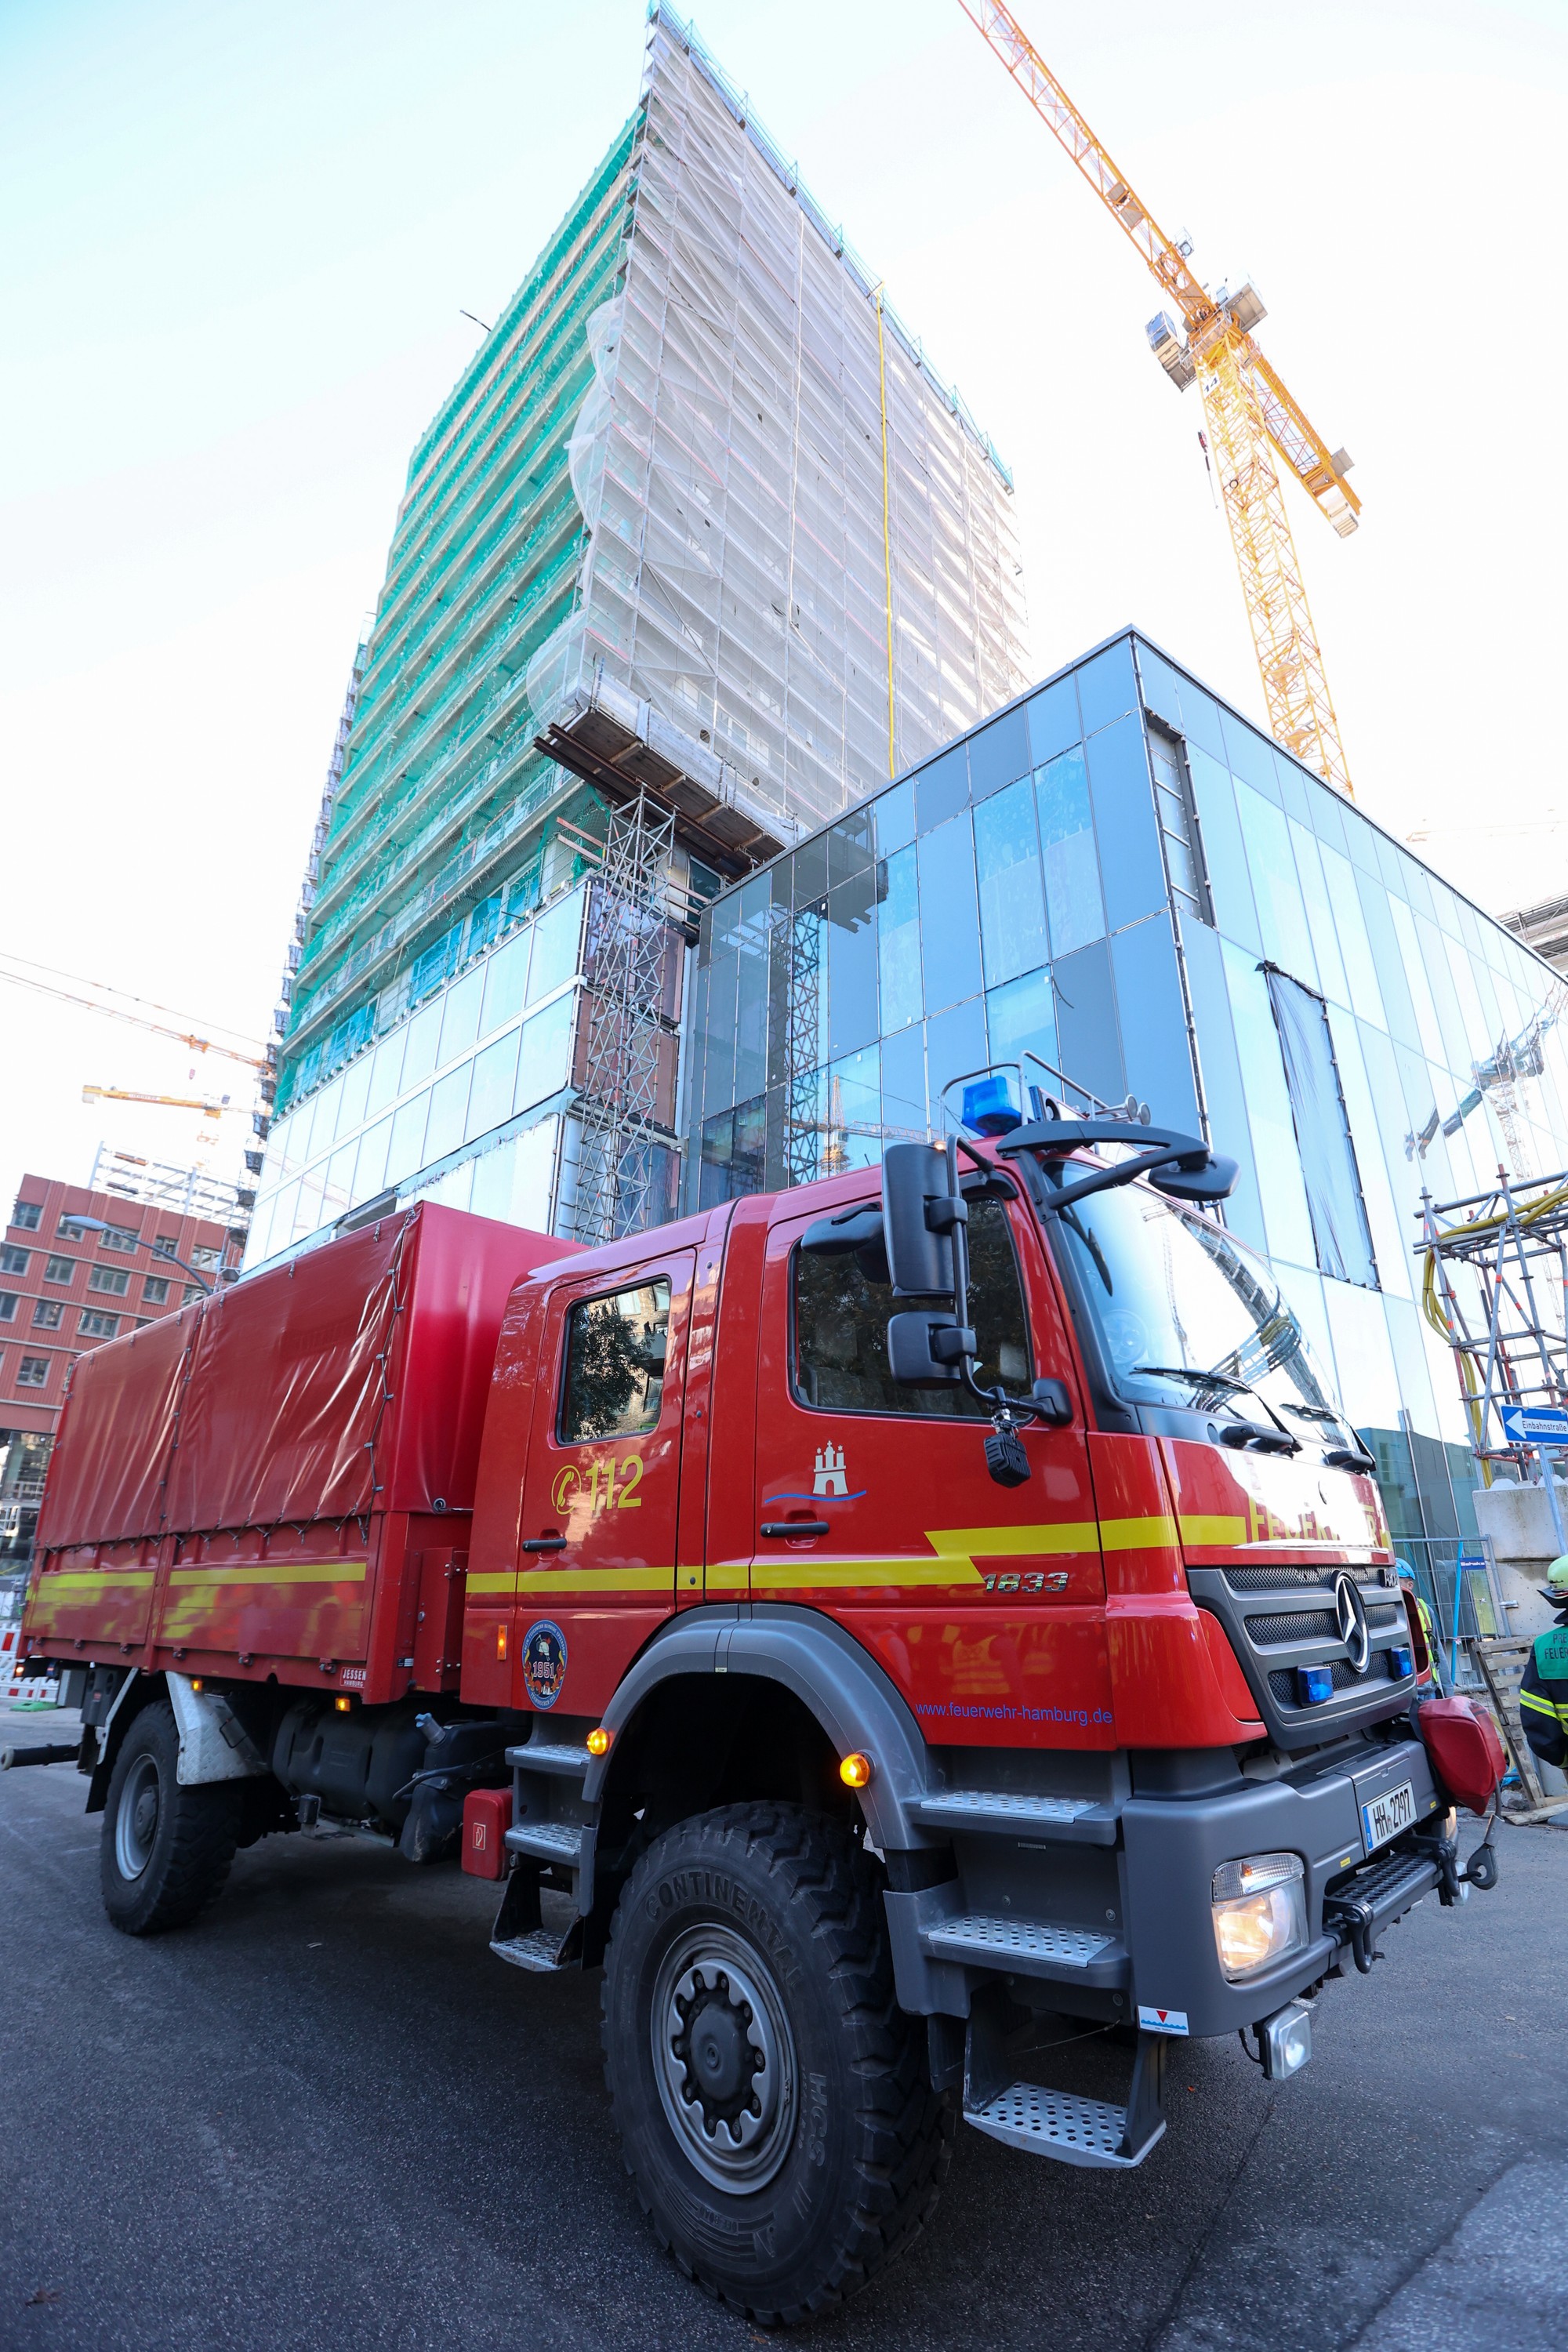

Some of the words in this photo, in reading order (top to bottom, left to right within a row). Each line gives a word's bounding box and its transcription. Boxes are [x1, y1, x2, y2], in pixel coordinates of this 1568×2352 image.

[1522, 1421, 1567, 1432] Einbahnstraße
[585, 1454, 644, 1511] 112
[982, 1572, 1069, 1593] 1833
[343, 1668, 366, 1681] JESSEN
[533, 1661, 554, 1679] 1951
[915, 1702, 1112, 1726] www.feuerwehr-hamburg.de
[588, 1802, 604, 1840] HH
[605, 1788, 627, 1829] 2797
[645, 1871, 804, 1987] CONTINENTAL
[808, 2072, 829, 2167] HCS
